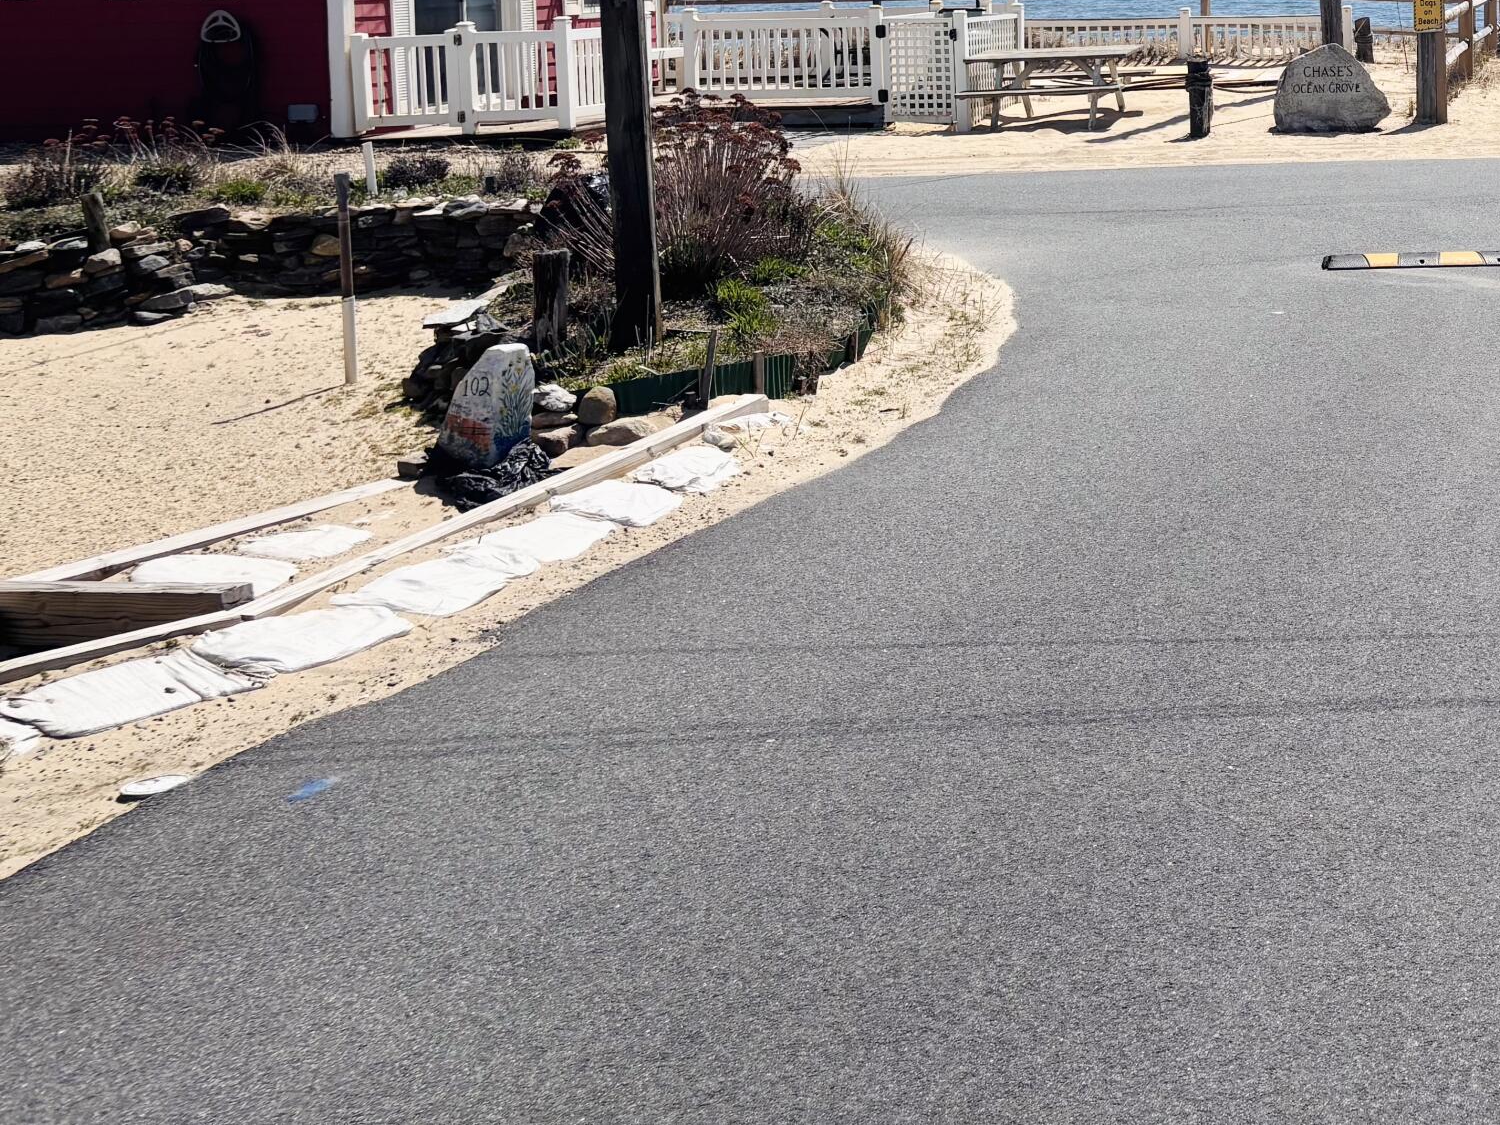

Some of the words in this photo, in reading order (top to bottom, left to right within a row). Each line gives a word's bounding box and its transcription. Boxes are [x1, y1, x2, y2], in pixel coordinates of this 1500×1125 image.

[1420, 0, 1437, 8] Dogs
[1418, 17, 1439, 25] Beach
[1303, 65, 1353, 78] CHASE'S
[1292, 82, 1325, 94] OCEAN
[1328, 81, 1361, 93] GROVE
[461, 376, 492, 397] 102
